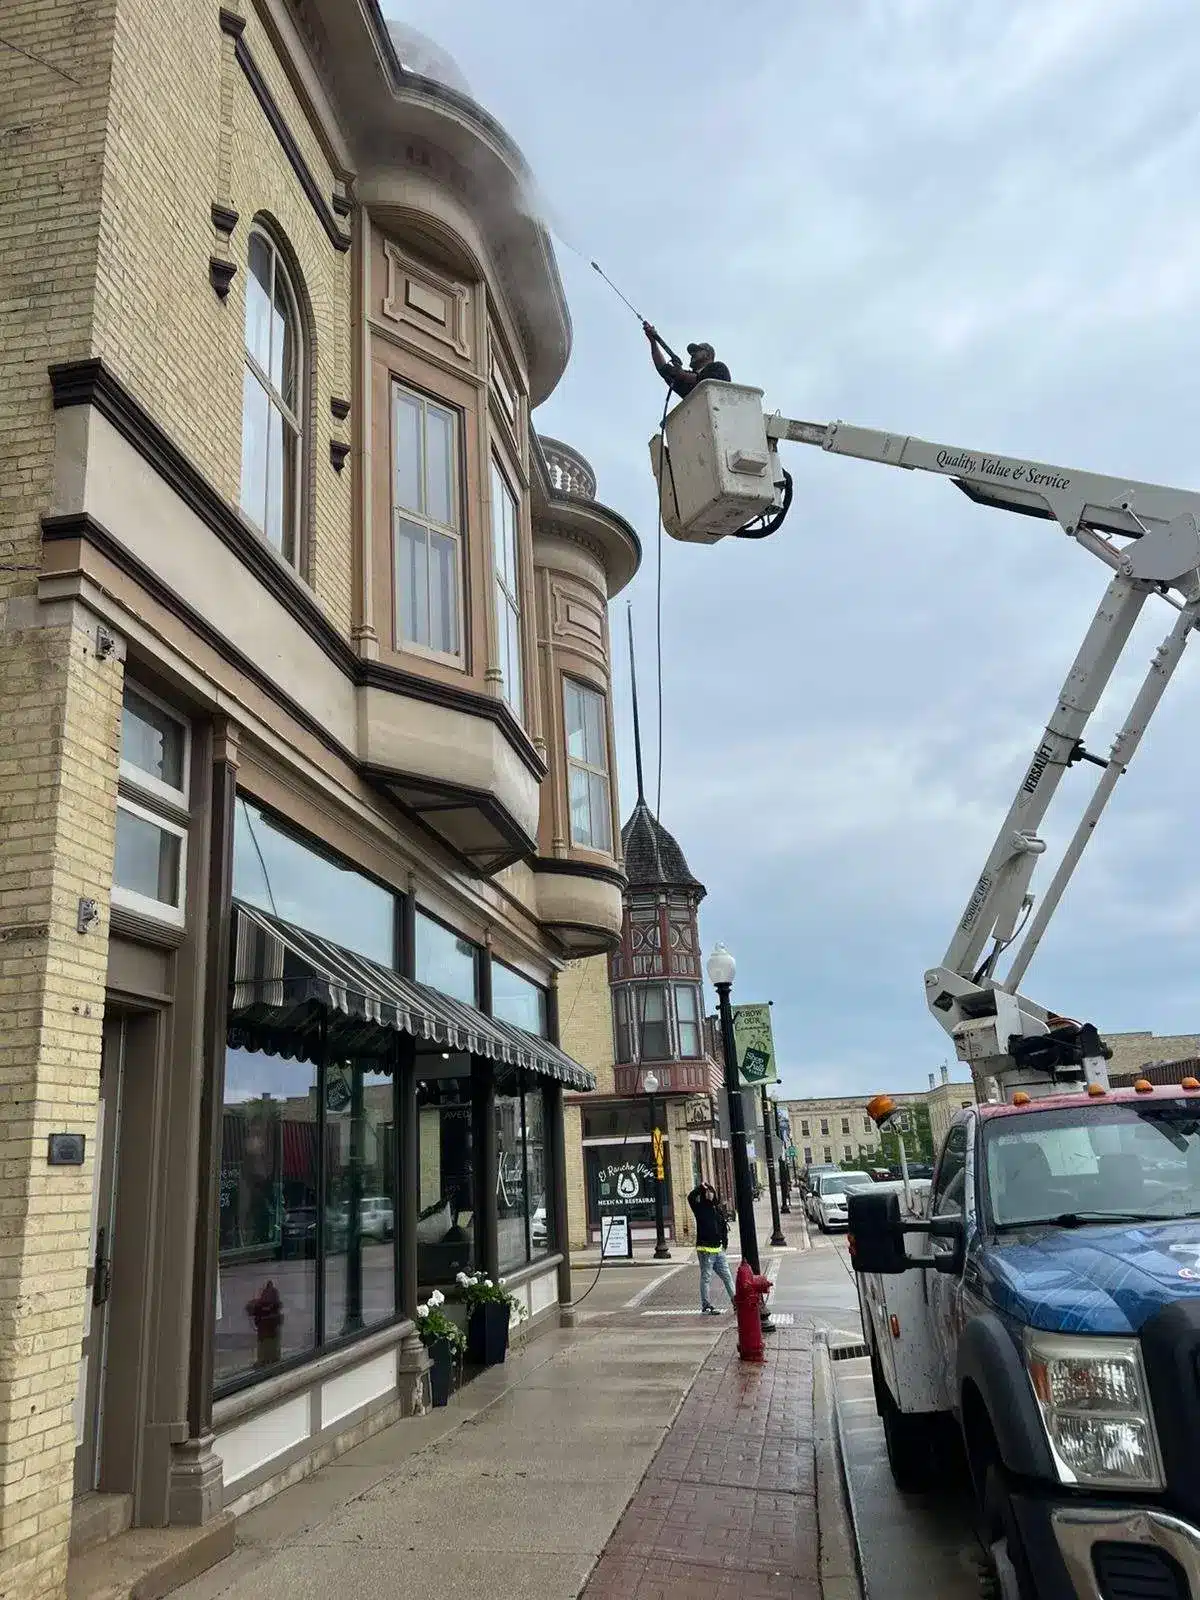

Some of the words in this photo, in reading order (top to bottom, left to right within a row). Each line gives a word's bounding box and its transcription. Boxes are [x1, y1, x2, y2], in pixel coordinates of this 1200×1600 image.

[936, 450, 977, 474] Quality,
[980, 458, 1011, 478] Value
[1012, 465, 1026, 480] &
[1025, 468, 1070, 490] Service
[1023, 743, 1053, 794] VERSALIFT
[607, 1162, 635, 1176] Rancho
[597, 1198, 624, 1206] MEXICAN
[624, 1197, 656, 1205] RESTAURA
